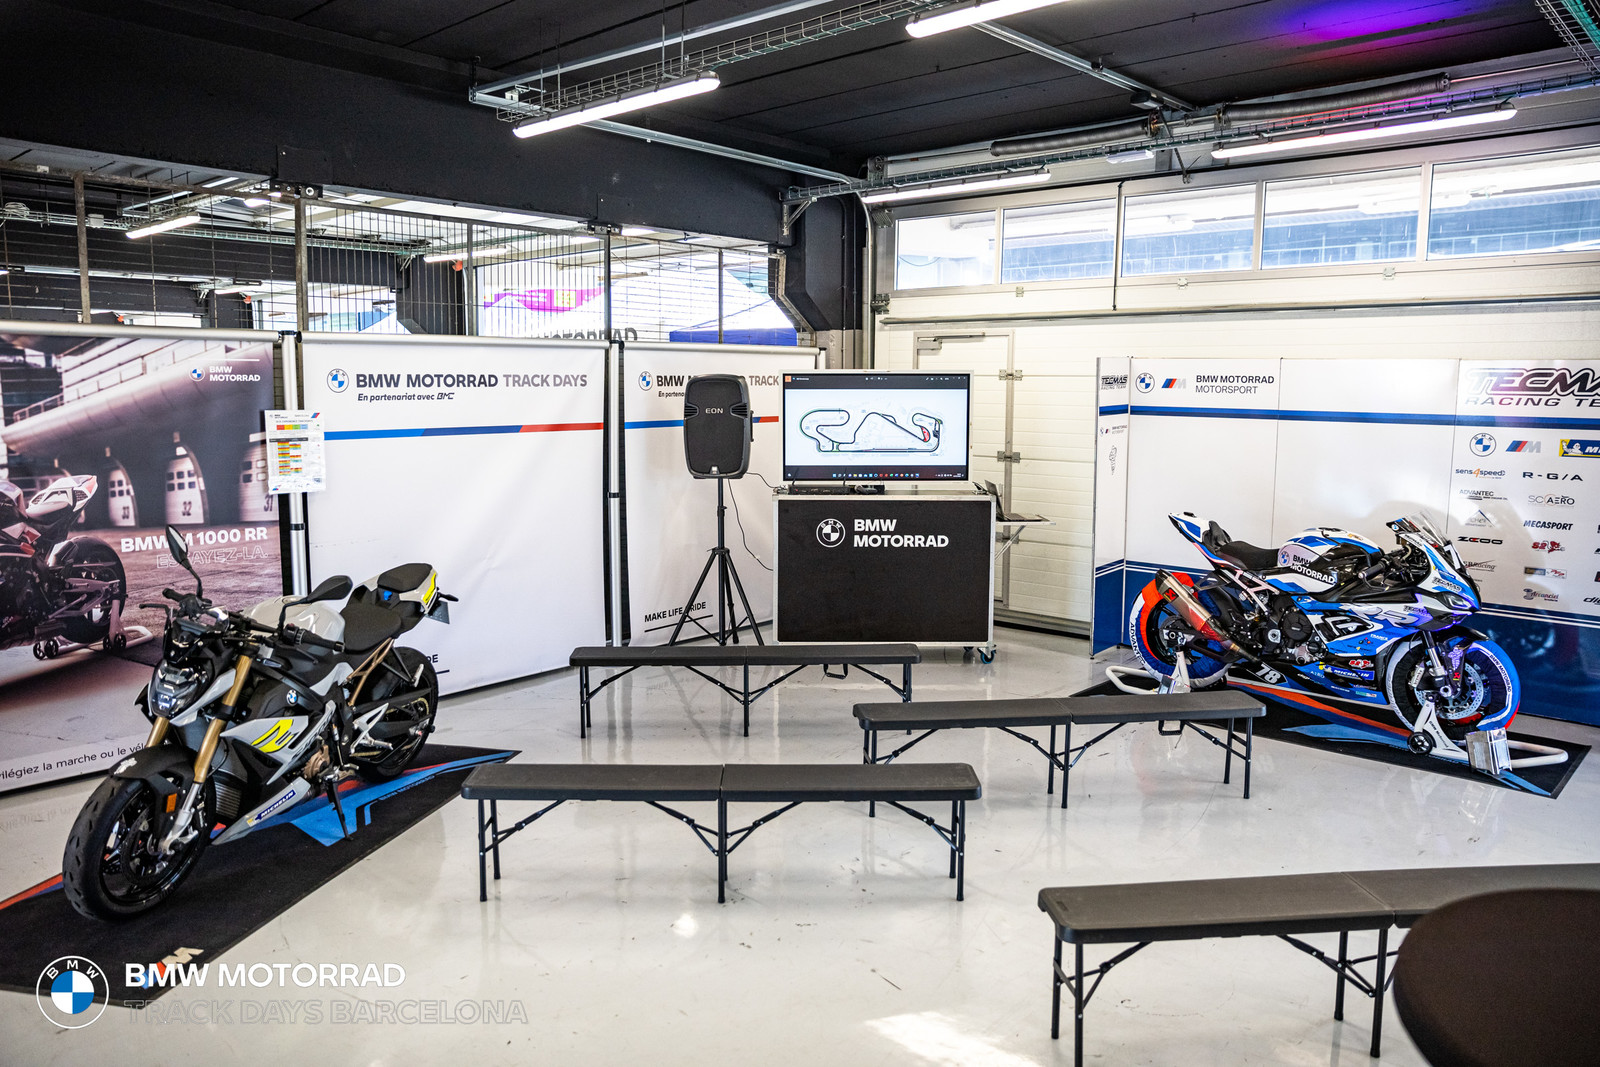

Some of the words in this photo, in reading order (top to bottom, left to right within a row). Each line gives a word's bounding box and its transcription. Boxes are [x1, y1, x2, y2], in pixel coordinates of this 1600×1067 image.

[209, 374, 261, 382] MOTORRAD
[356, 374, 401, 388] BMW
[406, 374, 498, 388] MOTORRAD
[503, 375, 550, 387] TRACK
[553, 375, 588, 387] DAYS
[656, 375, 684, 387] BMW
[749, 375, 779, 386] TRACK
[1196, 375, 1219, 383] BMW
[1220, 375, 1275, 384] MOTORRAD
[1465, 368, 1600, 396] TECM
[665, 391, 684, 399] partena
[1195, 385, 1258, 394] MOTORSPORT
[357, 393, 369, 401] En
[369, 392, 416, 403] partenariat
[1465, 397, 1561, 407] RACING
[1575, 398, 1600, 407] TE
[854, 519, 897, 531] BMW
[1523, 520, 1573, 531] MECASPORT
[121, 536, 168, 552] BMW
[196, 529, 241, 546] 1000
[244, 527, 268, 542] RR
[853, 535, 949, 547] MOTORRAD
[1292, 554, 1312, 567] BMW
[1290, 562, 1335, 584] MOTORRAD
[644, 611, 667, 623] MAKE
[668, 606, 684, 617] LIFE
[689, 601, 706, 613] RIDE
[1256, 663, 1281, 684] 78
[43, 762, 53, 771] la
[56, 754, 97, 768] marche
[100, 750, 114, 759] ou
[117, 747, 127, 756] le
[129, 743, 146, 753] vél
[261, 790, 294, 818] MICHELIN
